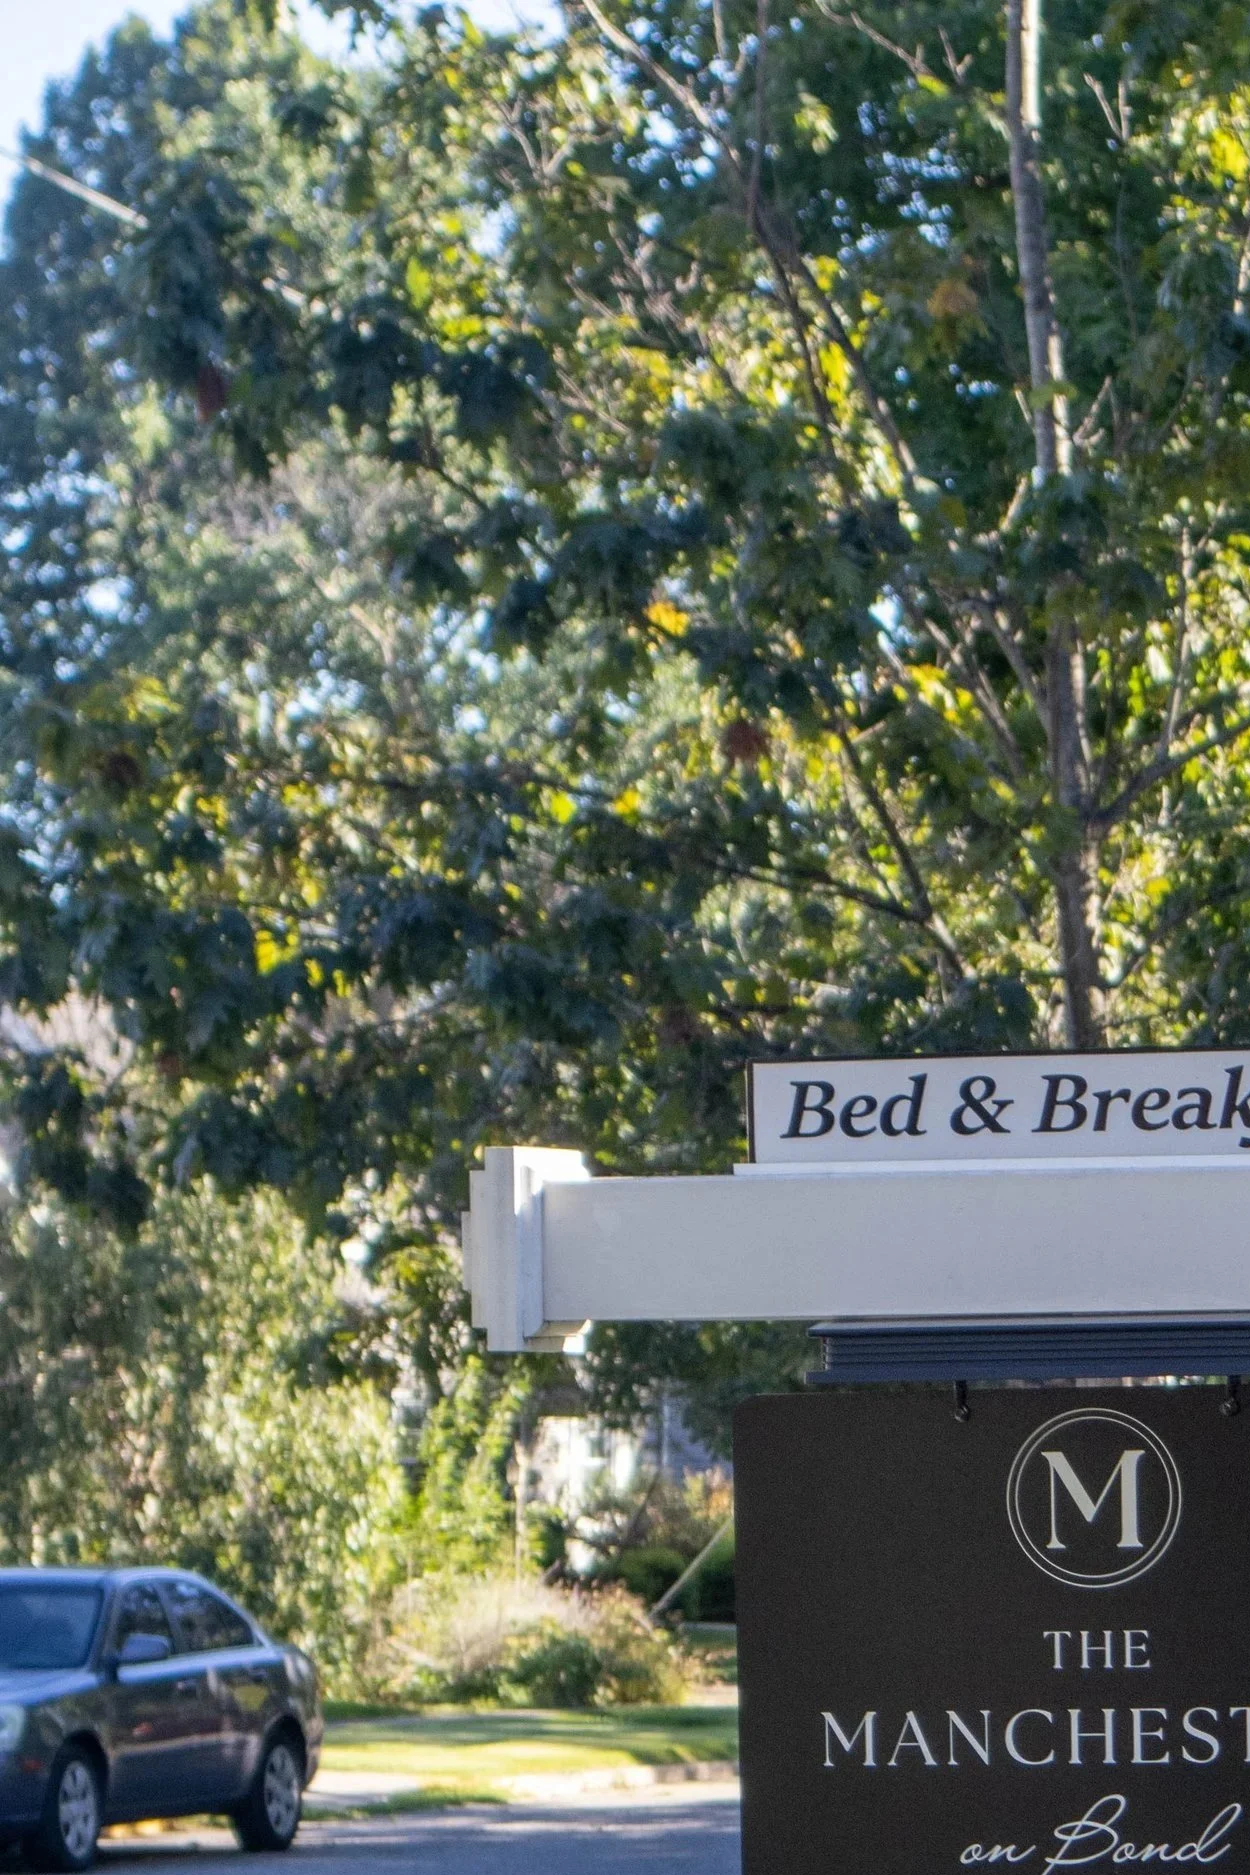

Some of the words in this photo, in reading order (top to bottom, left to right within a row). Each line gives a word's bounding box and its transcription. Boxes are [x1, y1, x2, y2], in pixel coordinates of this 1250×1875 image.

[779, 1072, 928, 1139] Bed
[949, 1075, 1012, 1136] &
[1040, 1449, 1146, 1549] M
[1042, 1629, 1152, 1670] THE
[958, 1842, 1037, 1866] on
